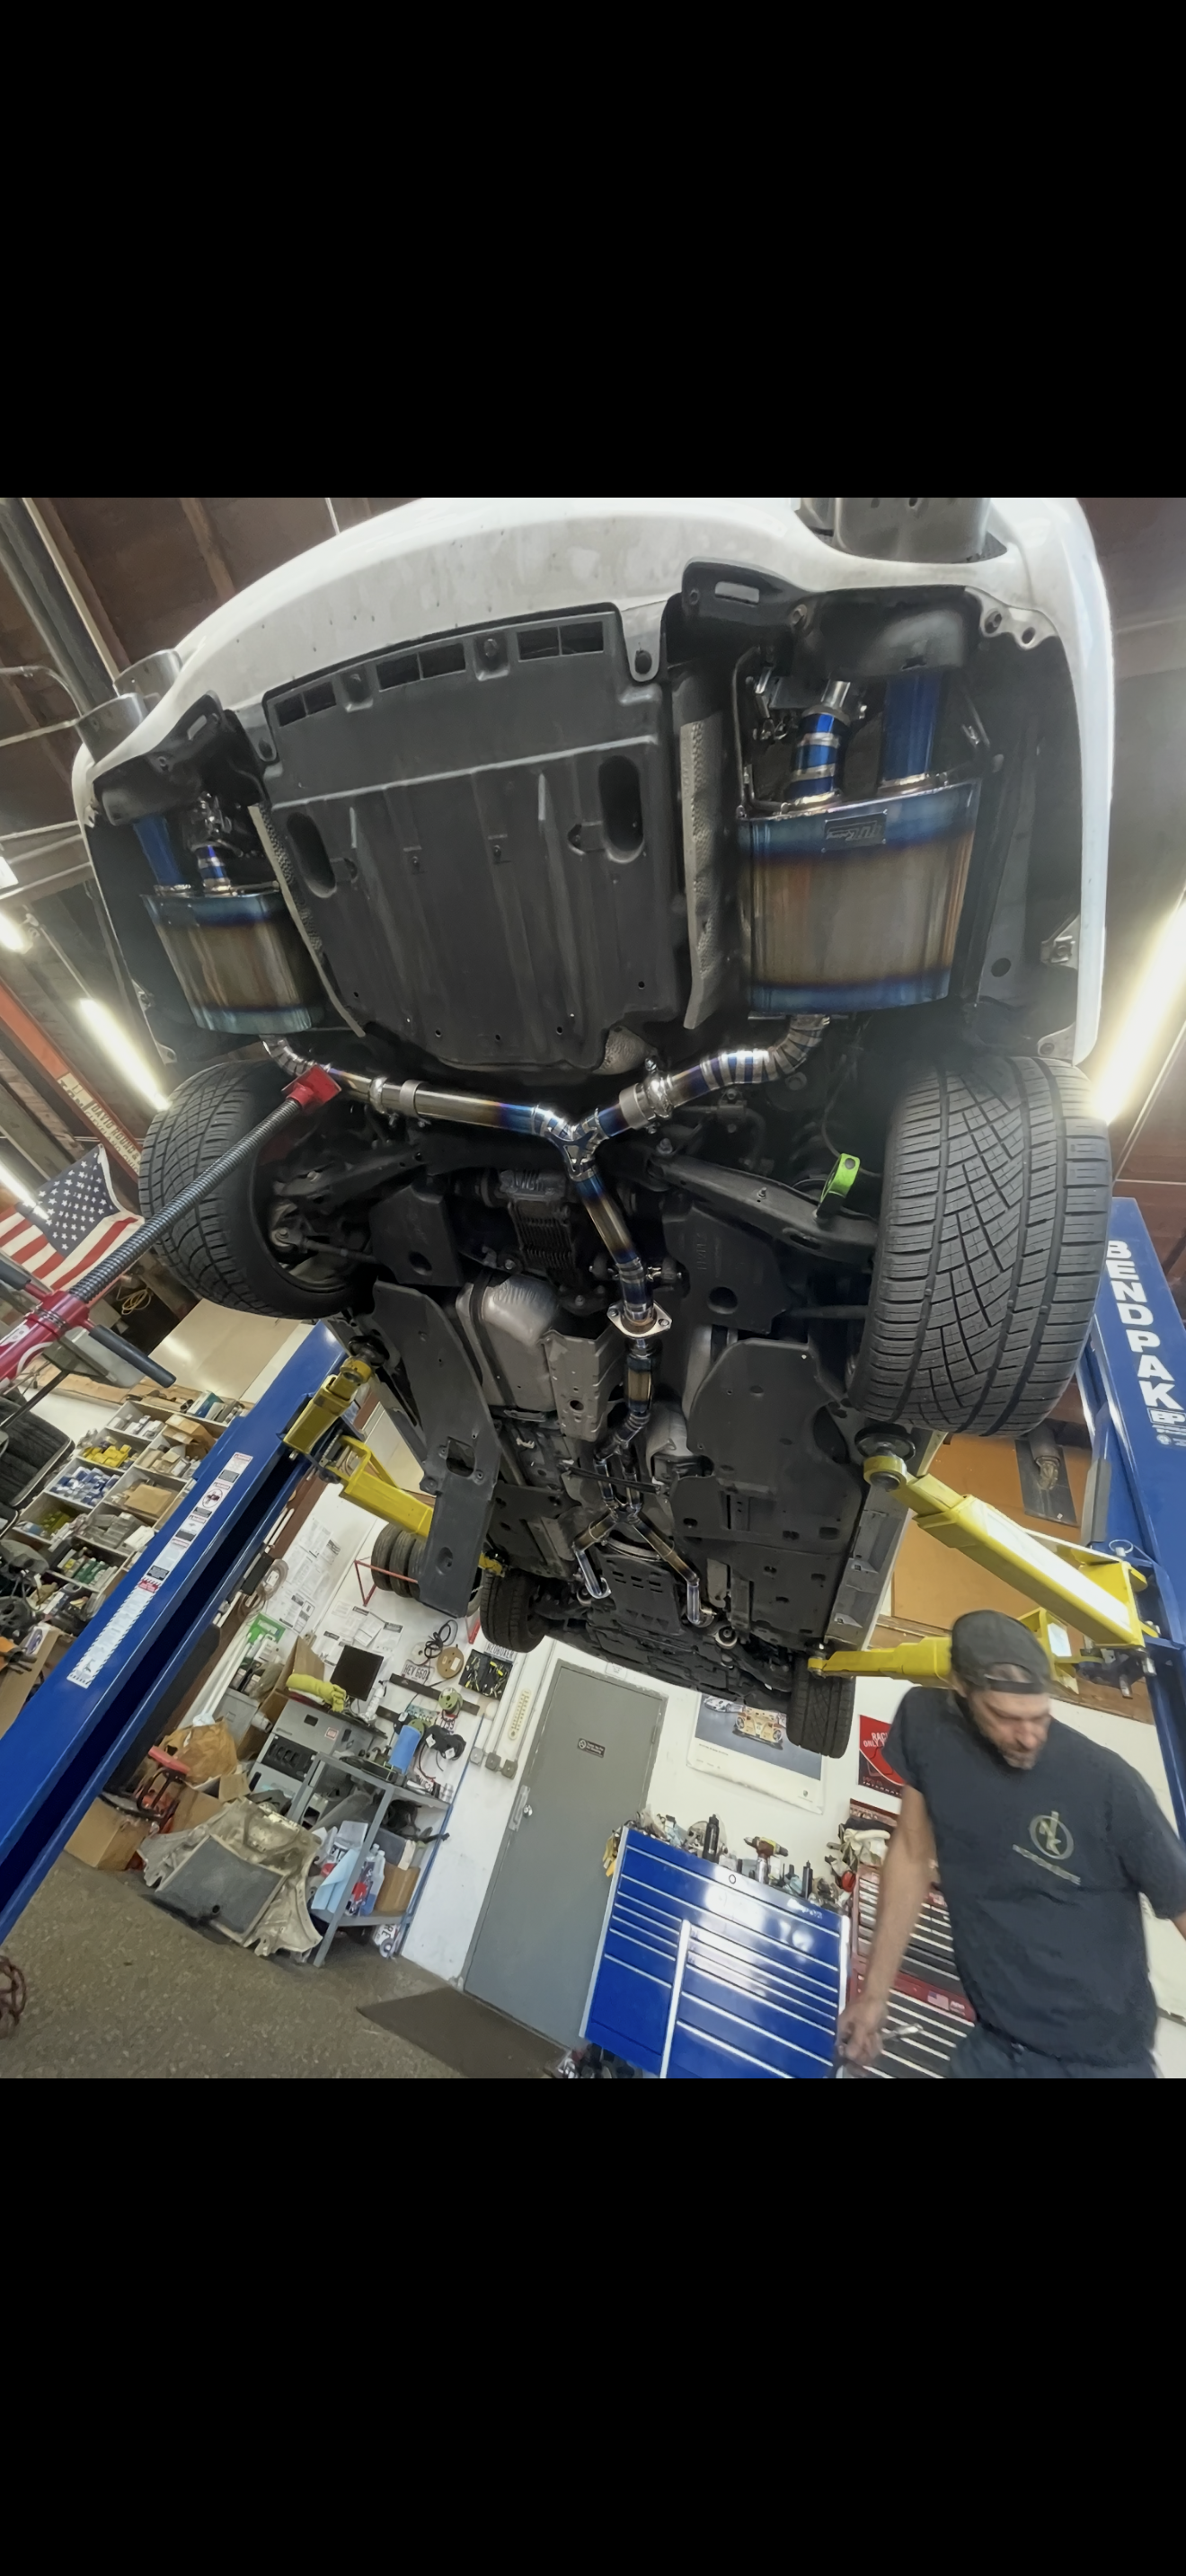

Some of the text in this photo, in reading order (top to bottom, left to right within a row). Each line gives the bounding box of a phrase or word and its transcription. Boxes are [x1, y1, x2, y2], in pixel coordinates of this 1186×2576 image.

[91, 1102, 115, 1129] DAVID
[111, 1125, 134, 1153] ROUND
[1106, 1240, 1184, 1410] BENDPAK
[1151, 1410, 1186, 1425] BP
